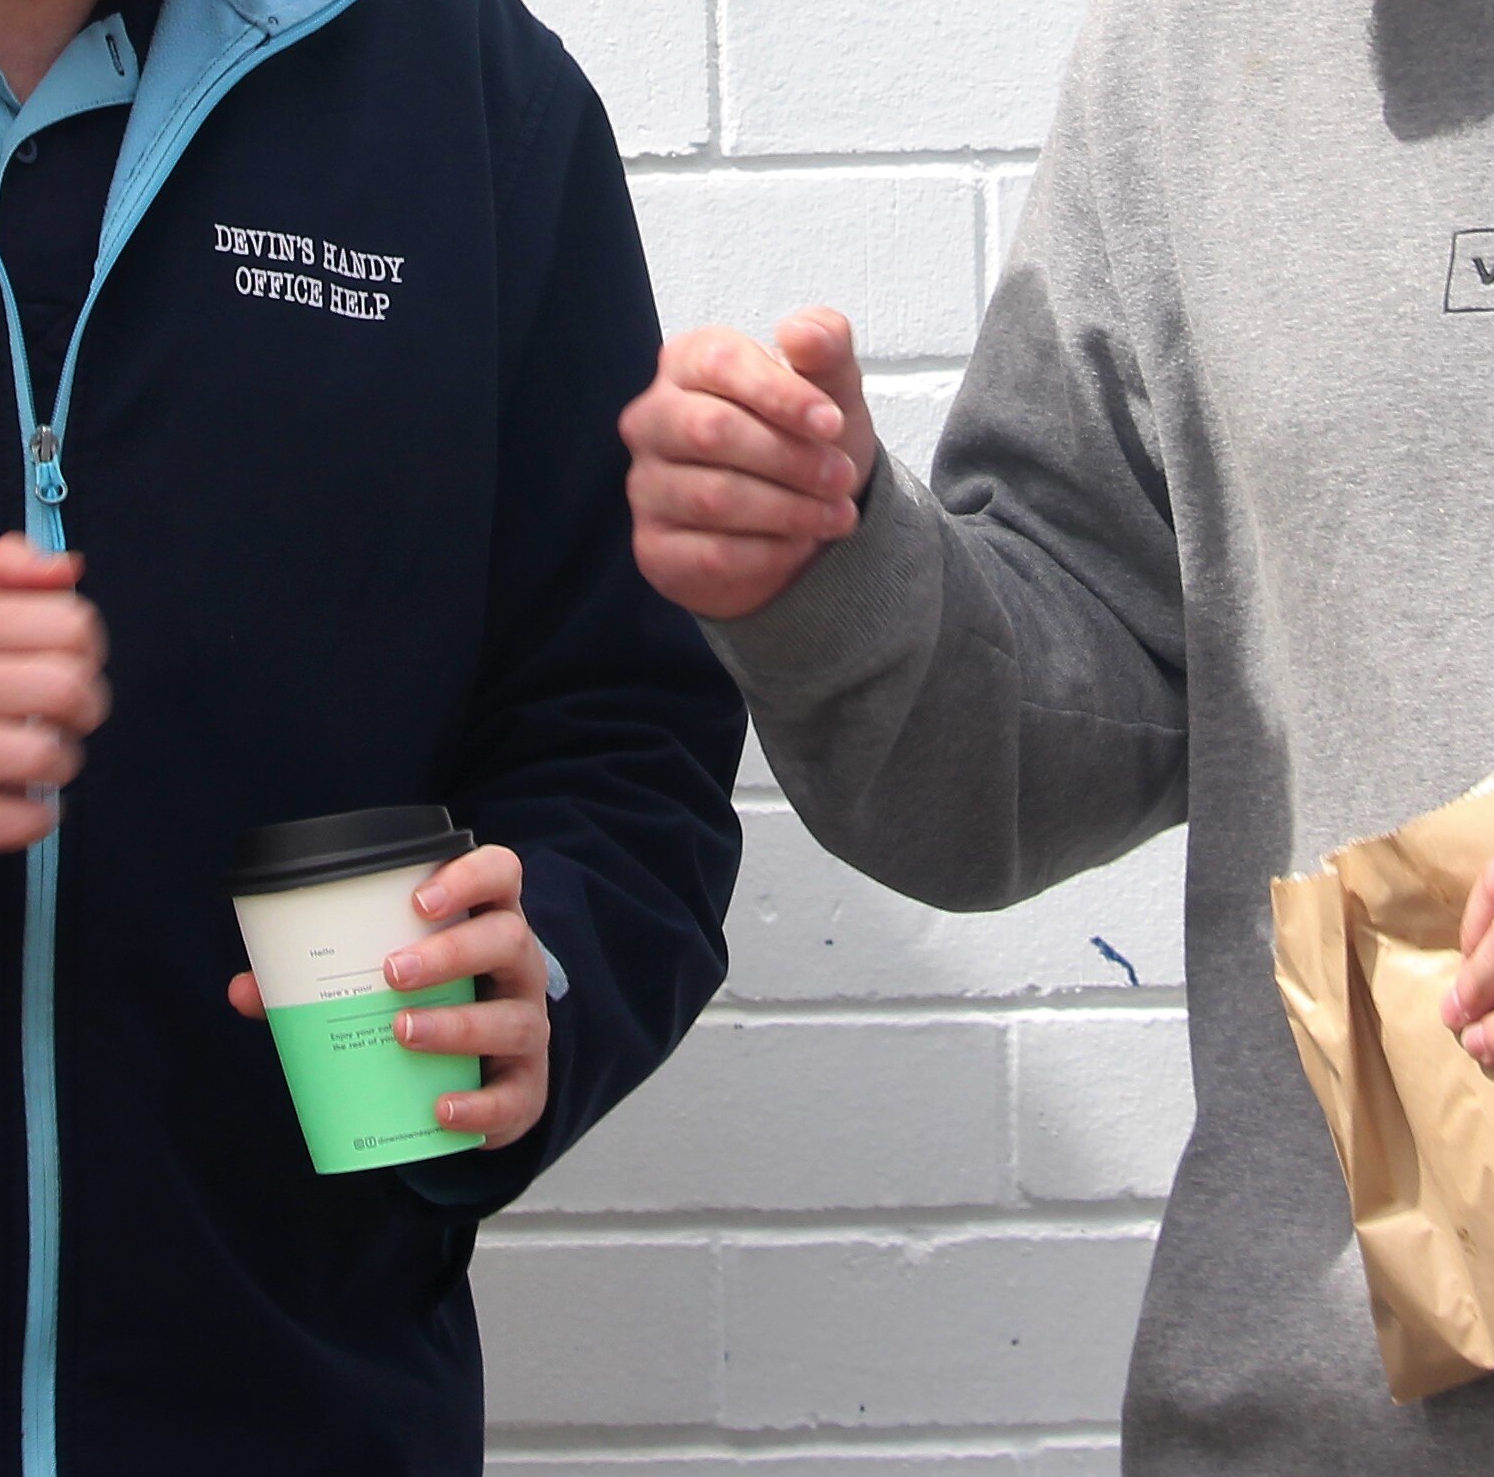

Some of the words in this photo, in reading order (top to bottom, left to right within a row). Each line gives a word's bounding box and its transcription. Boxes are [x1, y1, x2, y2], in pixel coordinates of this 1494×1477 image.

[214, 223, 316, 266] DEVIN'S
[322, 240, 405, 283] HANDY
[235, 266, 324, 308] OFFICE
[329, 282, 391, 321] HELP
